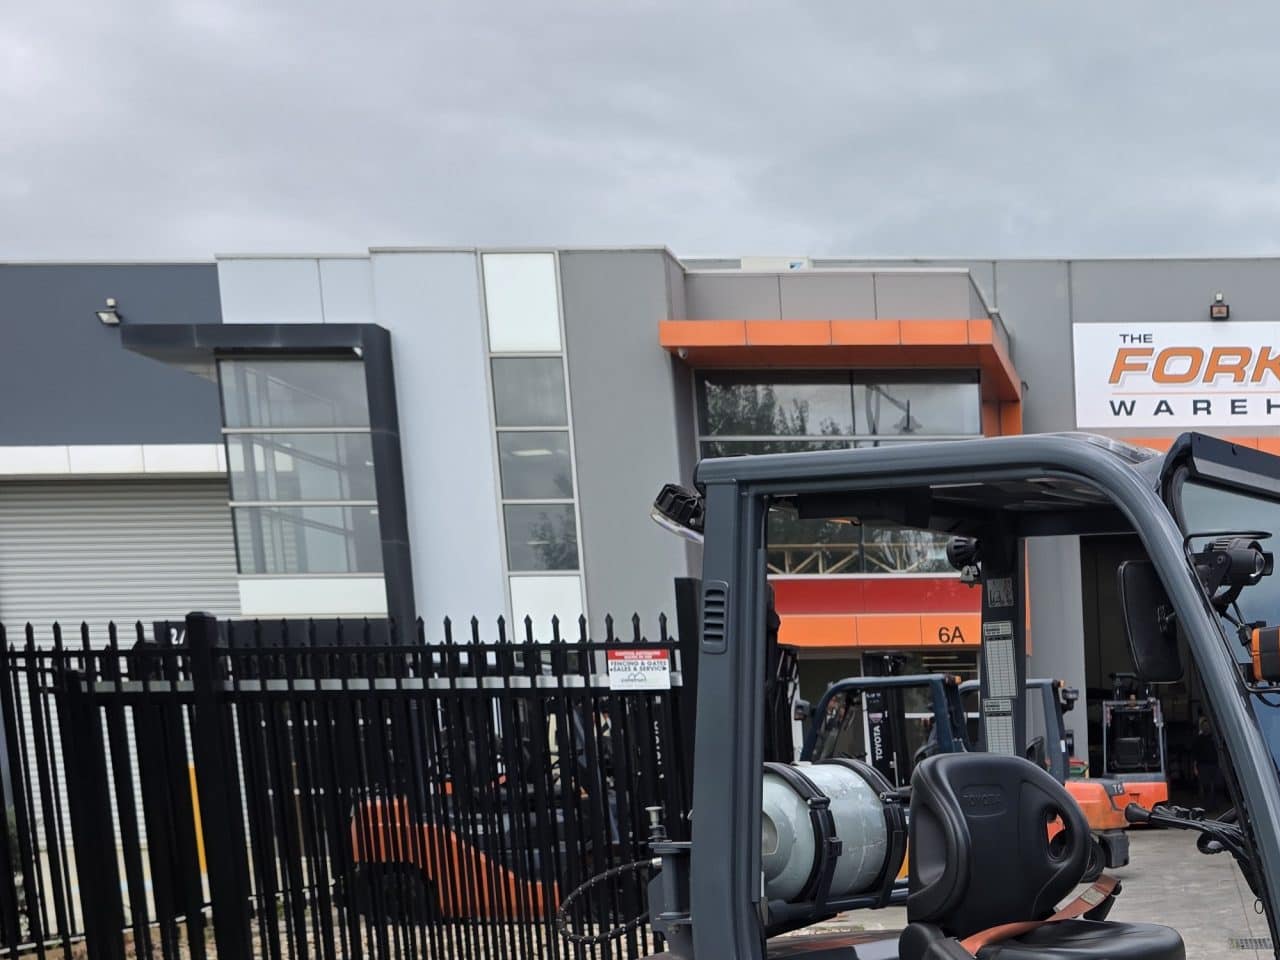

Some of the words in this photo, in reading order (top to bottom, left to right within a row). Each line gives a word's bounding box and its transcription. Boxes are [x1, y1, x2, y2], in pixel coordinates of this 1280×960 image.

[1119, 333, 1154, 344] THE
[938, 626, 965, 643] 6A
[873, 725, 884, 761] TOYOTA
